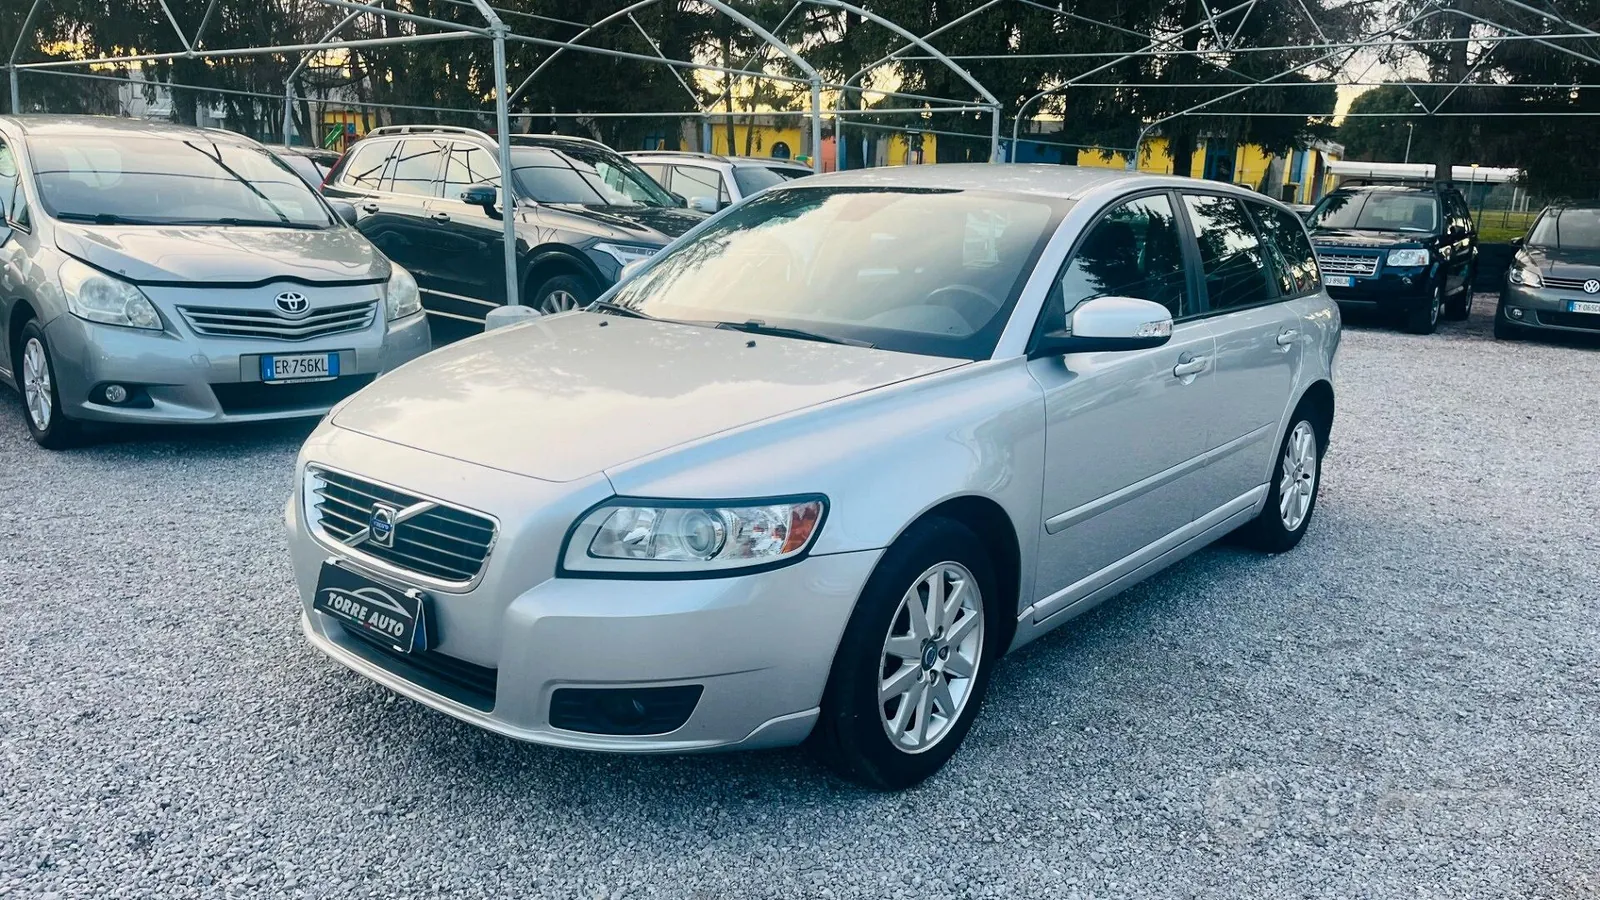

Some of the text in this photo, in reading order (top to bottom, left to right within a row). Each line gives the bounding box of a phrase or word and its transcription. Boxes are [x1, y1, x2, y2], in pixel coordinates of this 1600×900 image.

[275, 360, 289, 374] ER
[292, 358, 328, 374] 756KL
[328, 592, 404, 636] TORRE AUTO
